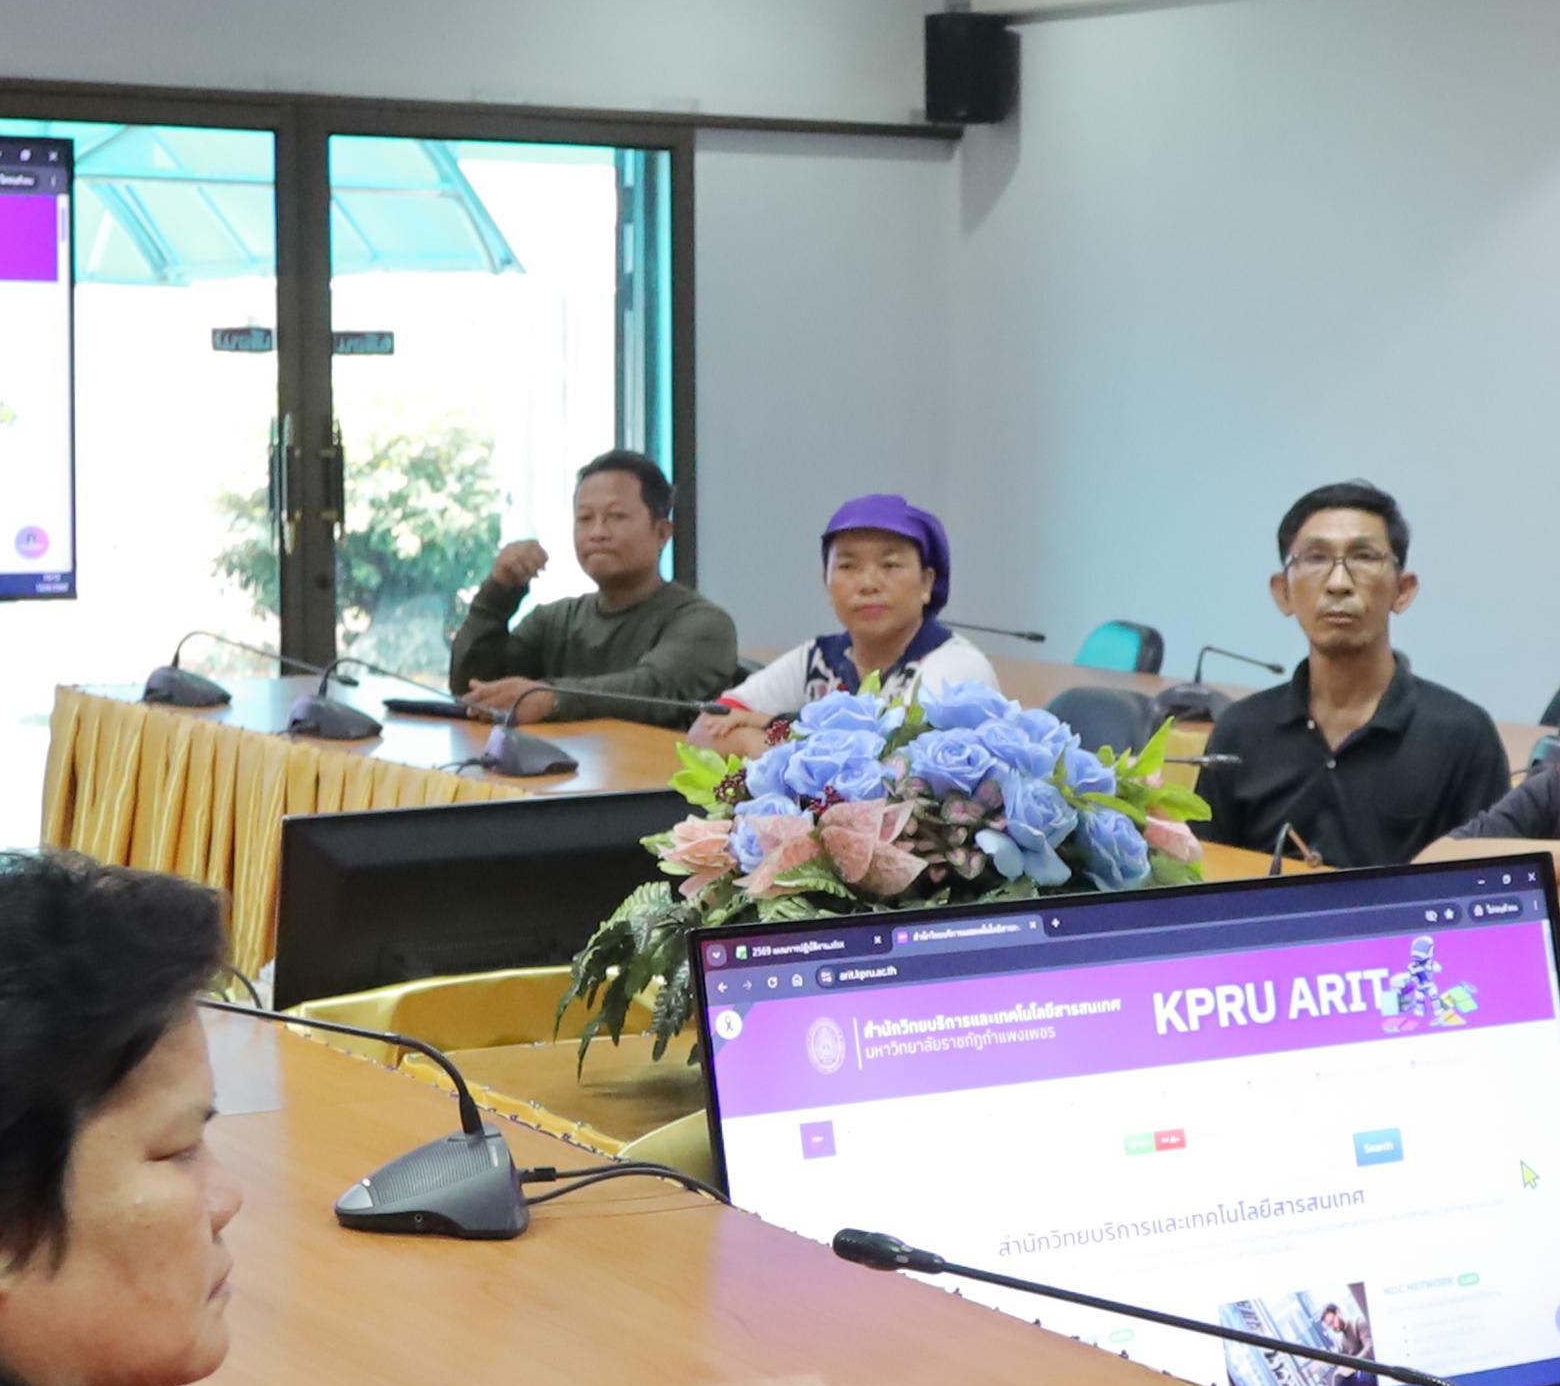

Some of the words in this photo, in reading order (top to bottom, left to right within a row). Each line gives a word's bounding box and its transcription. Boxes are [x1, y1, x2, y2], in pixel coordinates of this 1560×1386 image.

[864, 997, 1122, 1038] สำนักวิทยบริการและเทคโนโลยีสารสนเทศ
[1153, 980, 1277, 1035] KPRU
[1289, 967, 1390, 1020] ARIT
[998, 1188, 1366, 1258] สำนักวิทยบริการและเทคโนโลยีสารสนเทศ
